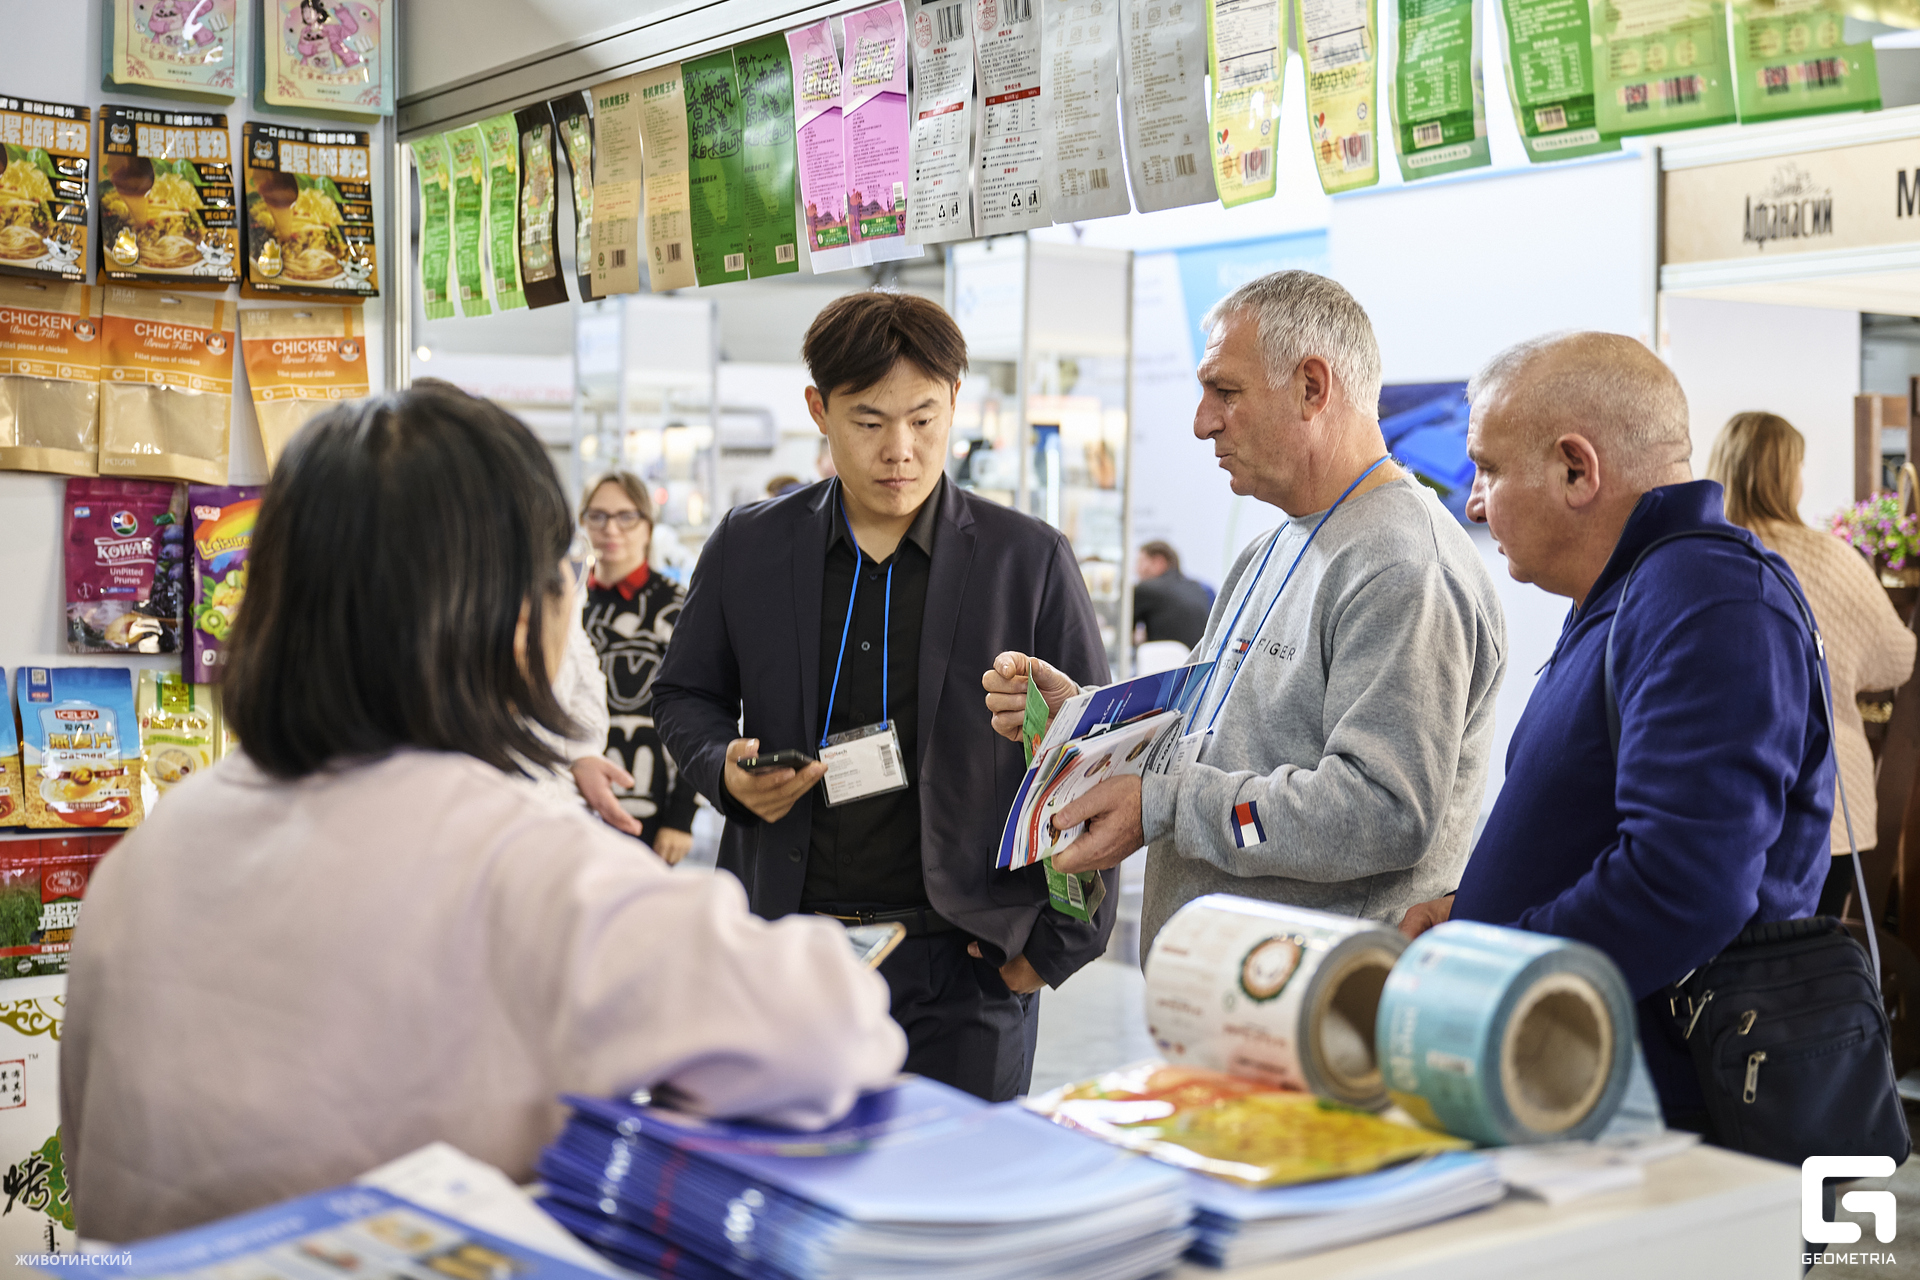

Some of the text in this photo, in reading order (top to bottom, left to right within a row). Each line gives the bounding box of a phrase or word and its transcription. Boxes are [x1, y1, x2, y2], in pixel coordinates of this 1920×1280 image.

[0, 310, 72, 331] CHICKEN
[10, 325, 60, 339] Breast Fillet
[134, 322, 204, 343] CHICKEN
[45, 344, 68, 354] chicken
[144, 337, 193, 351] Breast Fillet
[272, 339, 338, 355] CHICKEN
[198, 535, 252, 556] Leisure
[109, 567, 144, 577] UnPitted
[114, 577, 141, 586] Prunes
[1256, 638, 1296, 661] FIGER
[60, 751, 106, 760] Oatmeal
[38, 915, 78, 930] JERK
[41, 944, 70, 953] EXTRA
